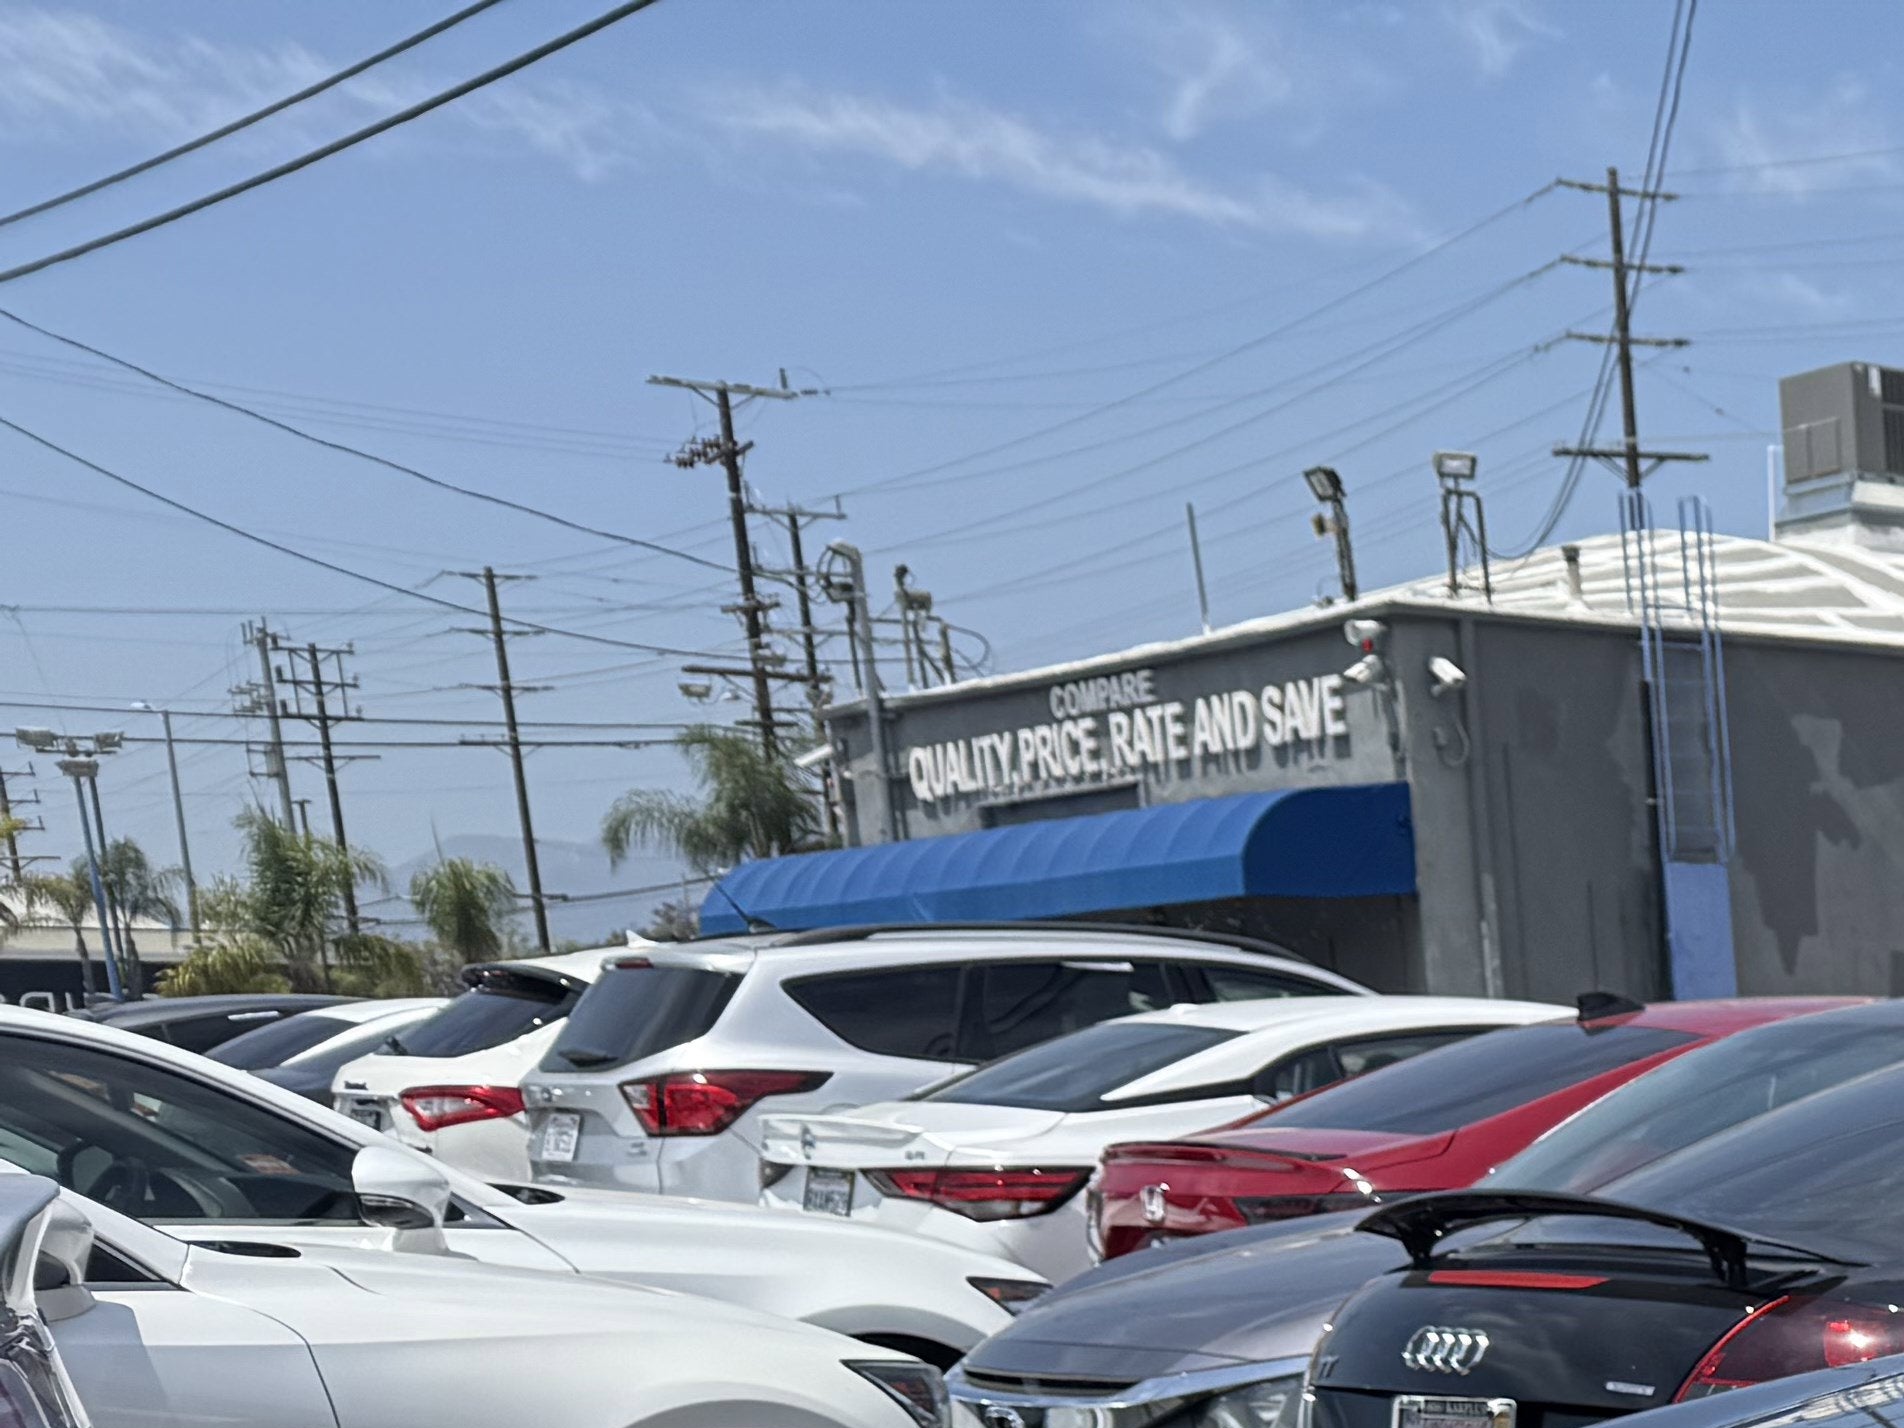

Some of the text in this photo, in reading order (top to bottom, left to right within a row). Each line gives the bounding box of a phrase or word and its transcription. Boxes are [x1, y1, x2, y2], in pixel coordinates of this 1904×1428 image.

[1049, 669, 1158, 720] COMPARE
[1109, 703, 1187, 768] RATE
[1193, 690, 1258, 757] AND
[1262, 674, 1348, 745] SAVE
